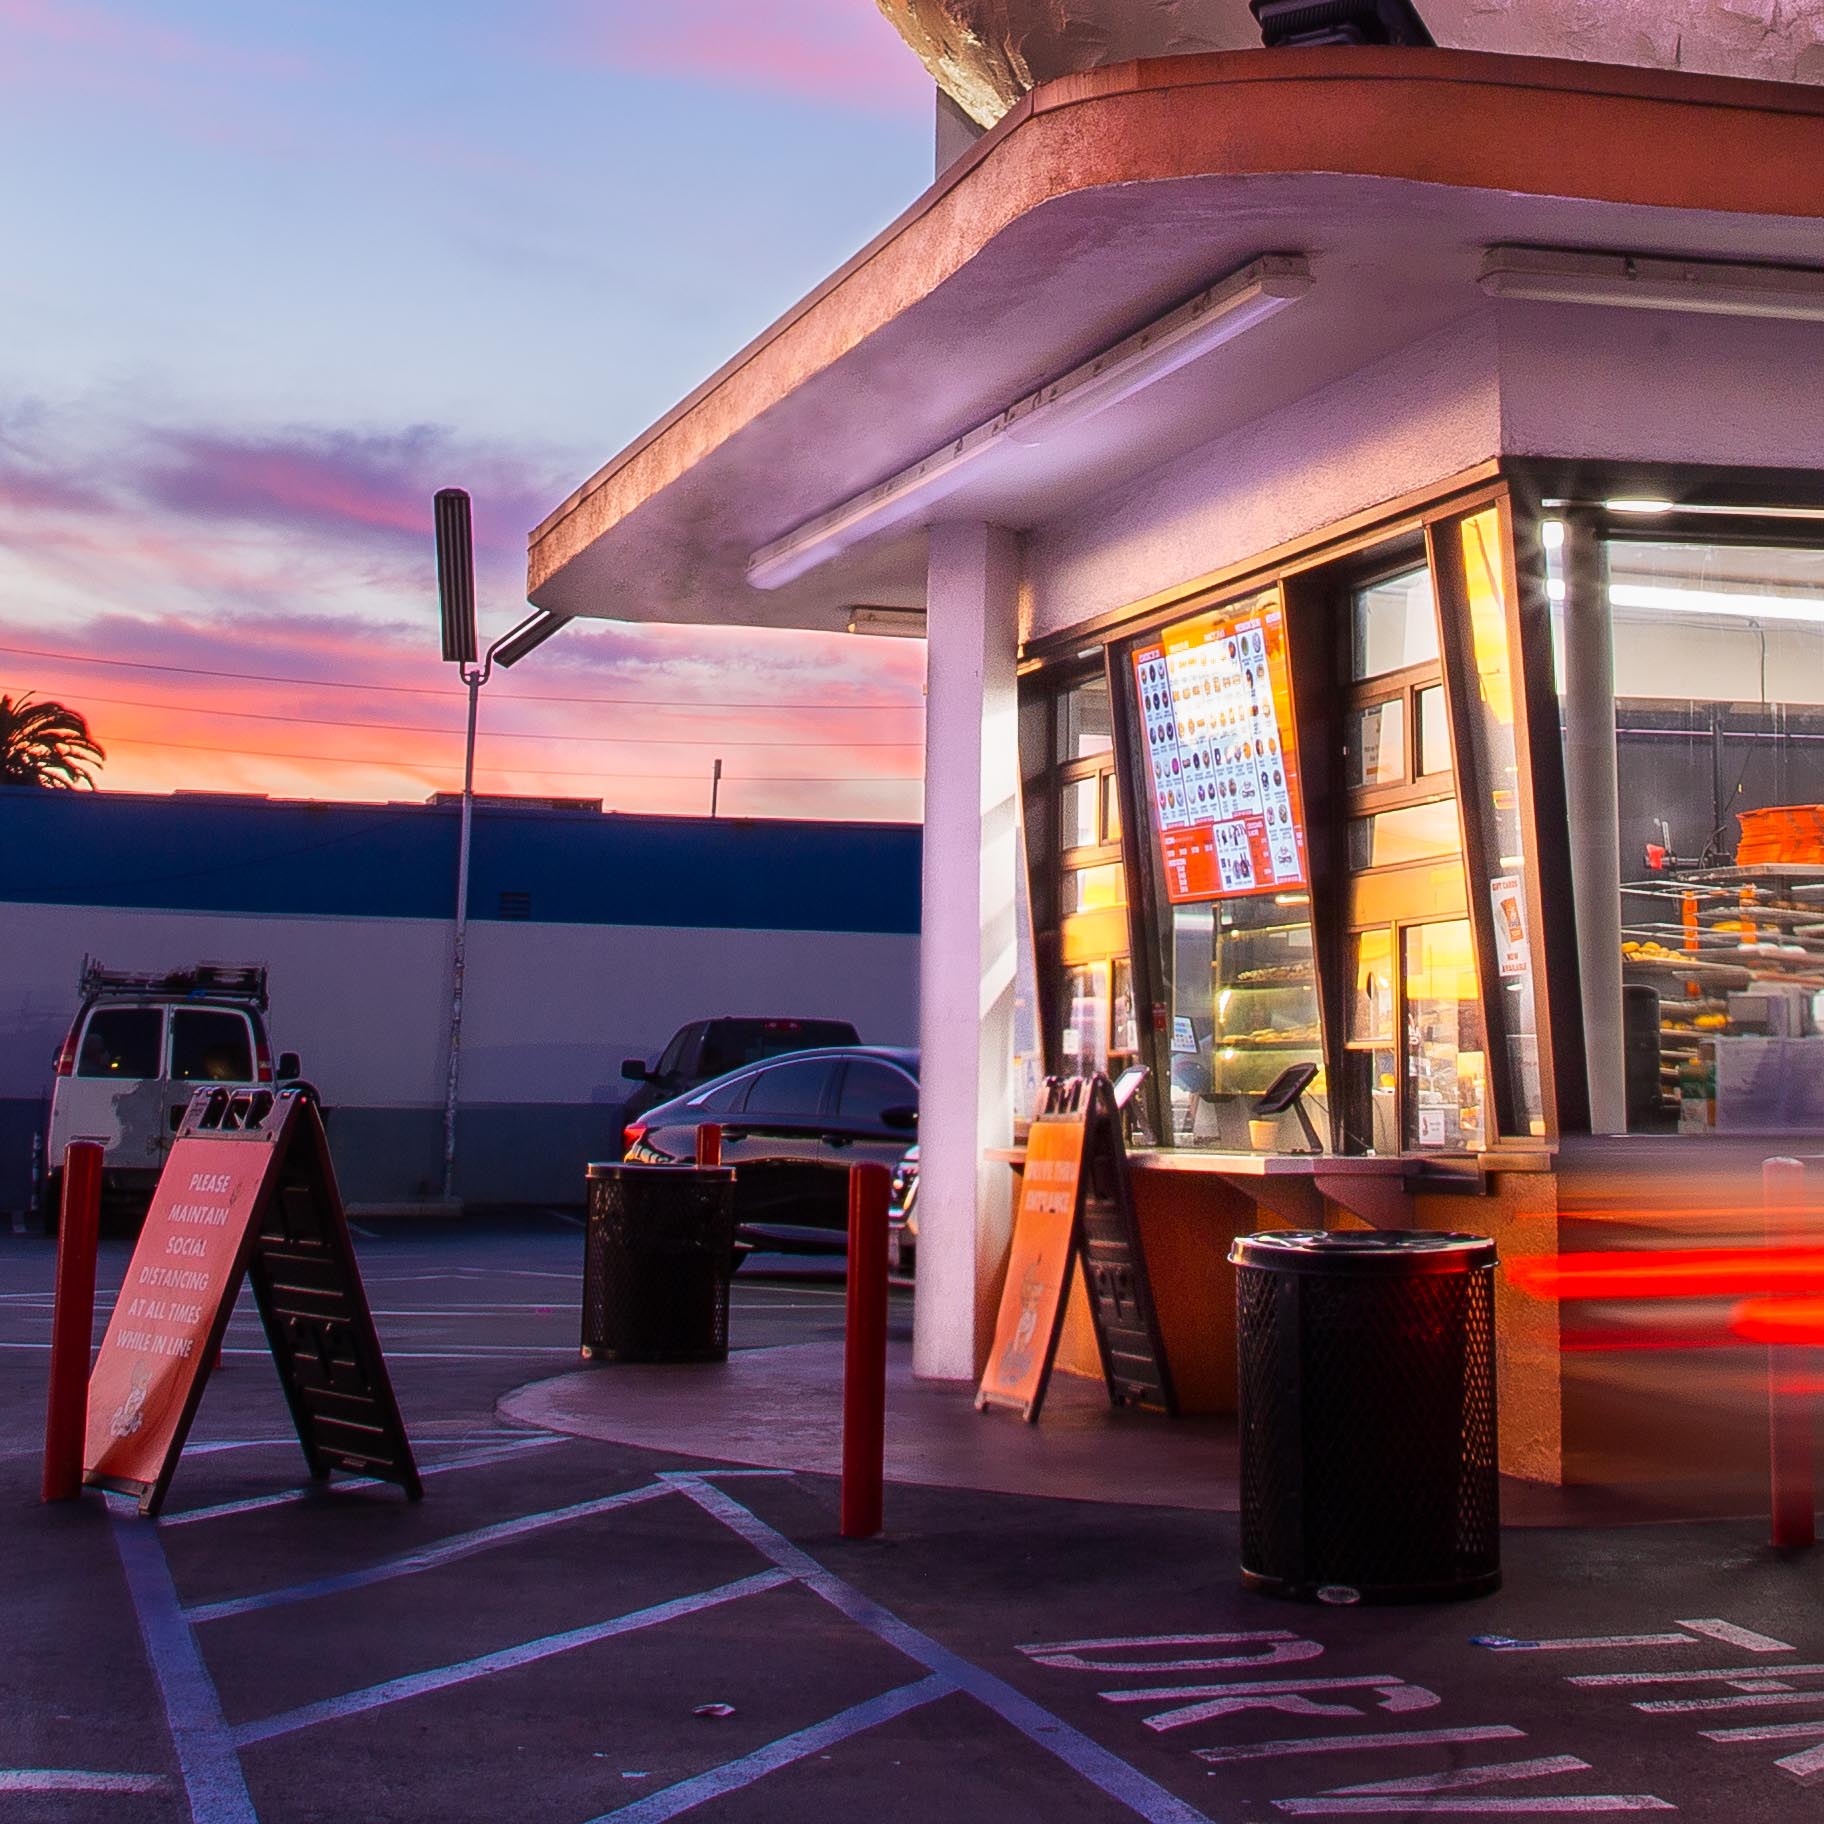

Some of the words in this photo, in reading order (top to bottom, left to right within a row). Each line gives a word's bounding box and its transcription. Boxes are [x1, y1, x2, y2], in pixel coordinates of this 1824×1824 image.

[189, 1173, 230, 1193] PLEASE
[168, 1204, 229, 1226] MAINTAIN
[166, 1236, 207, 1257] SOCIAL
[139, 1266, 209, 1291] DISTANCING
[128, 1298, 144, 1315] AT
[146, 1300, 164, 1320] ALL
[169, 1303, 201, 1325] TIMES
[116, 1329, 151, 1351] WHILE
[153, 1334, 167, 1354] IN
[167, 1337, 194, 1358] LINE
